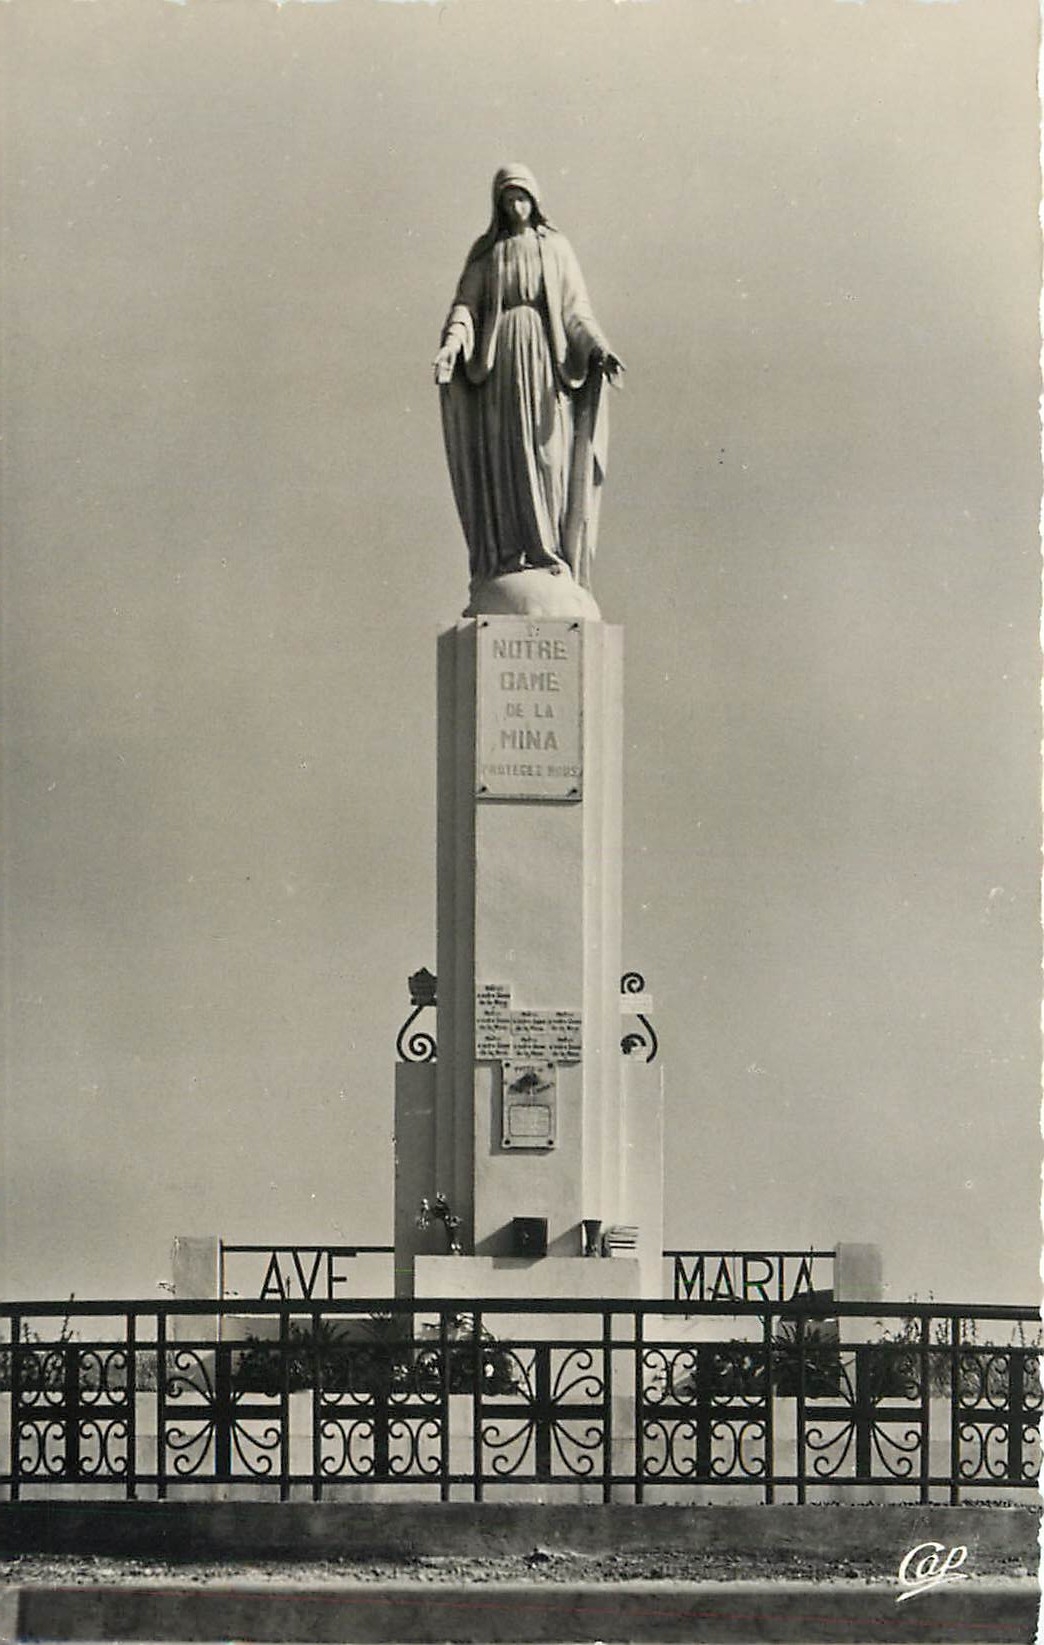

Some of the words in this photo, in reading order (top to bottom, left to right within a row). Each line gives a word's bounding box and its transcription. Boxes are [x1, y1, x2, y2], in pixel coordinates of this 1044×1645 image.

[493, 639, 568, 660] NOTRE
[500, 671, 560, 692] DAME
[506, 702, 524, 718] DE
[534, 702, 554, 718] LA
[500, 729, 559, 750] MINA
[259, 1250, 357, 1301] AVE
[673, 1254, 815, 1302] MARIA
